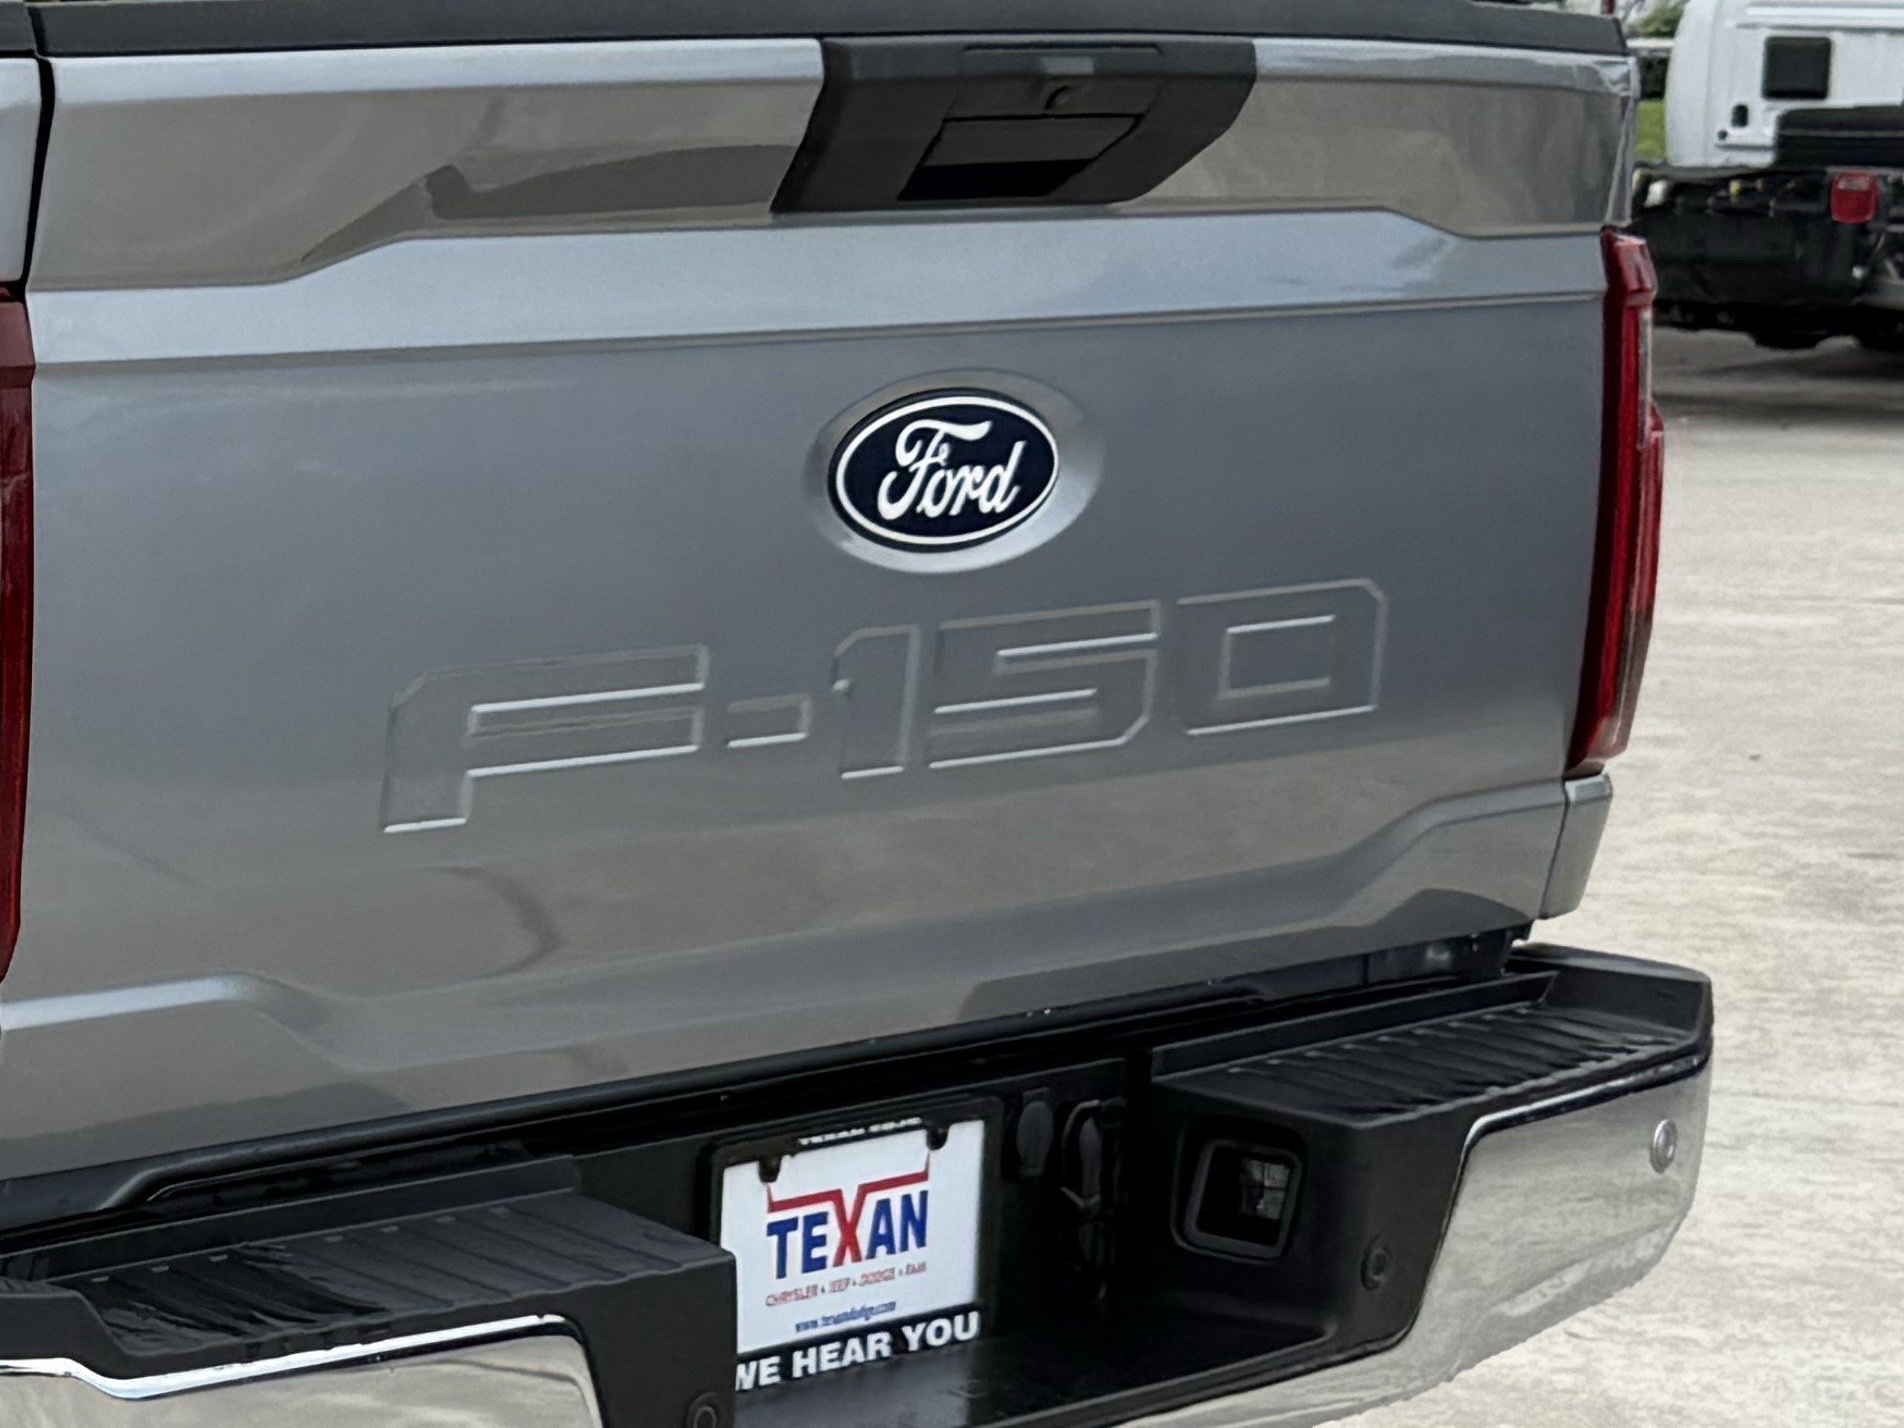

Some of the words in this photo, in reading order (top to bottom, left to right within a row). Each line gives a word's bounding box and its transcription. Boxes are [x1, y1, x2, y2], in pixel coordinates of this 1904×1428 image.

[876, 417, 1024, 521] Ford
[381, 577, 1388, 834] F-150
[765, 1175, 930, 1280] TEXAN
[792, 1330, 892, 1379] HEAR
[900, 1311, 981, 1352] YOU
